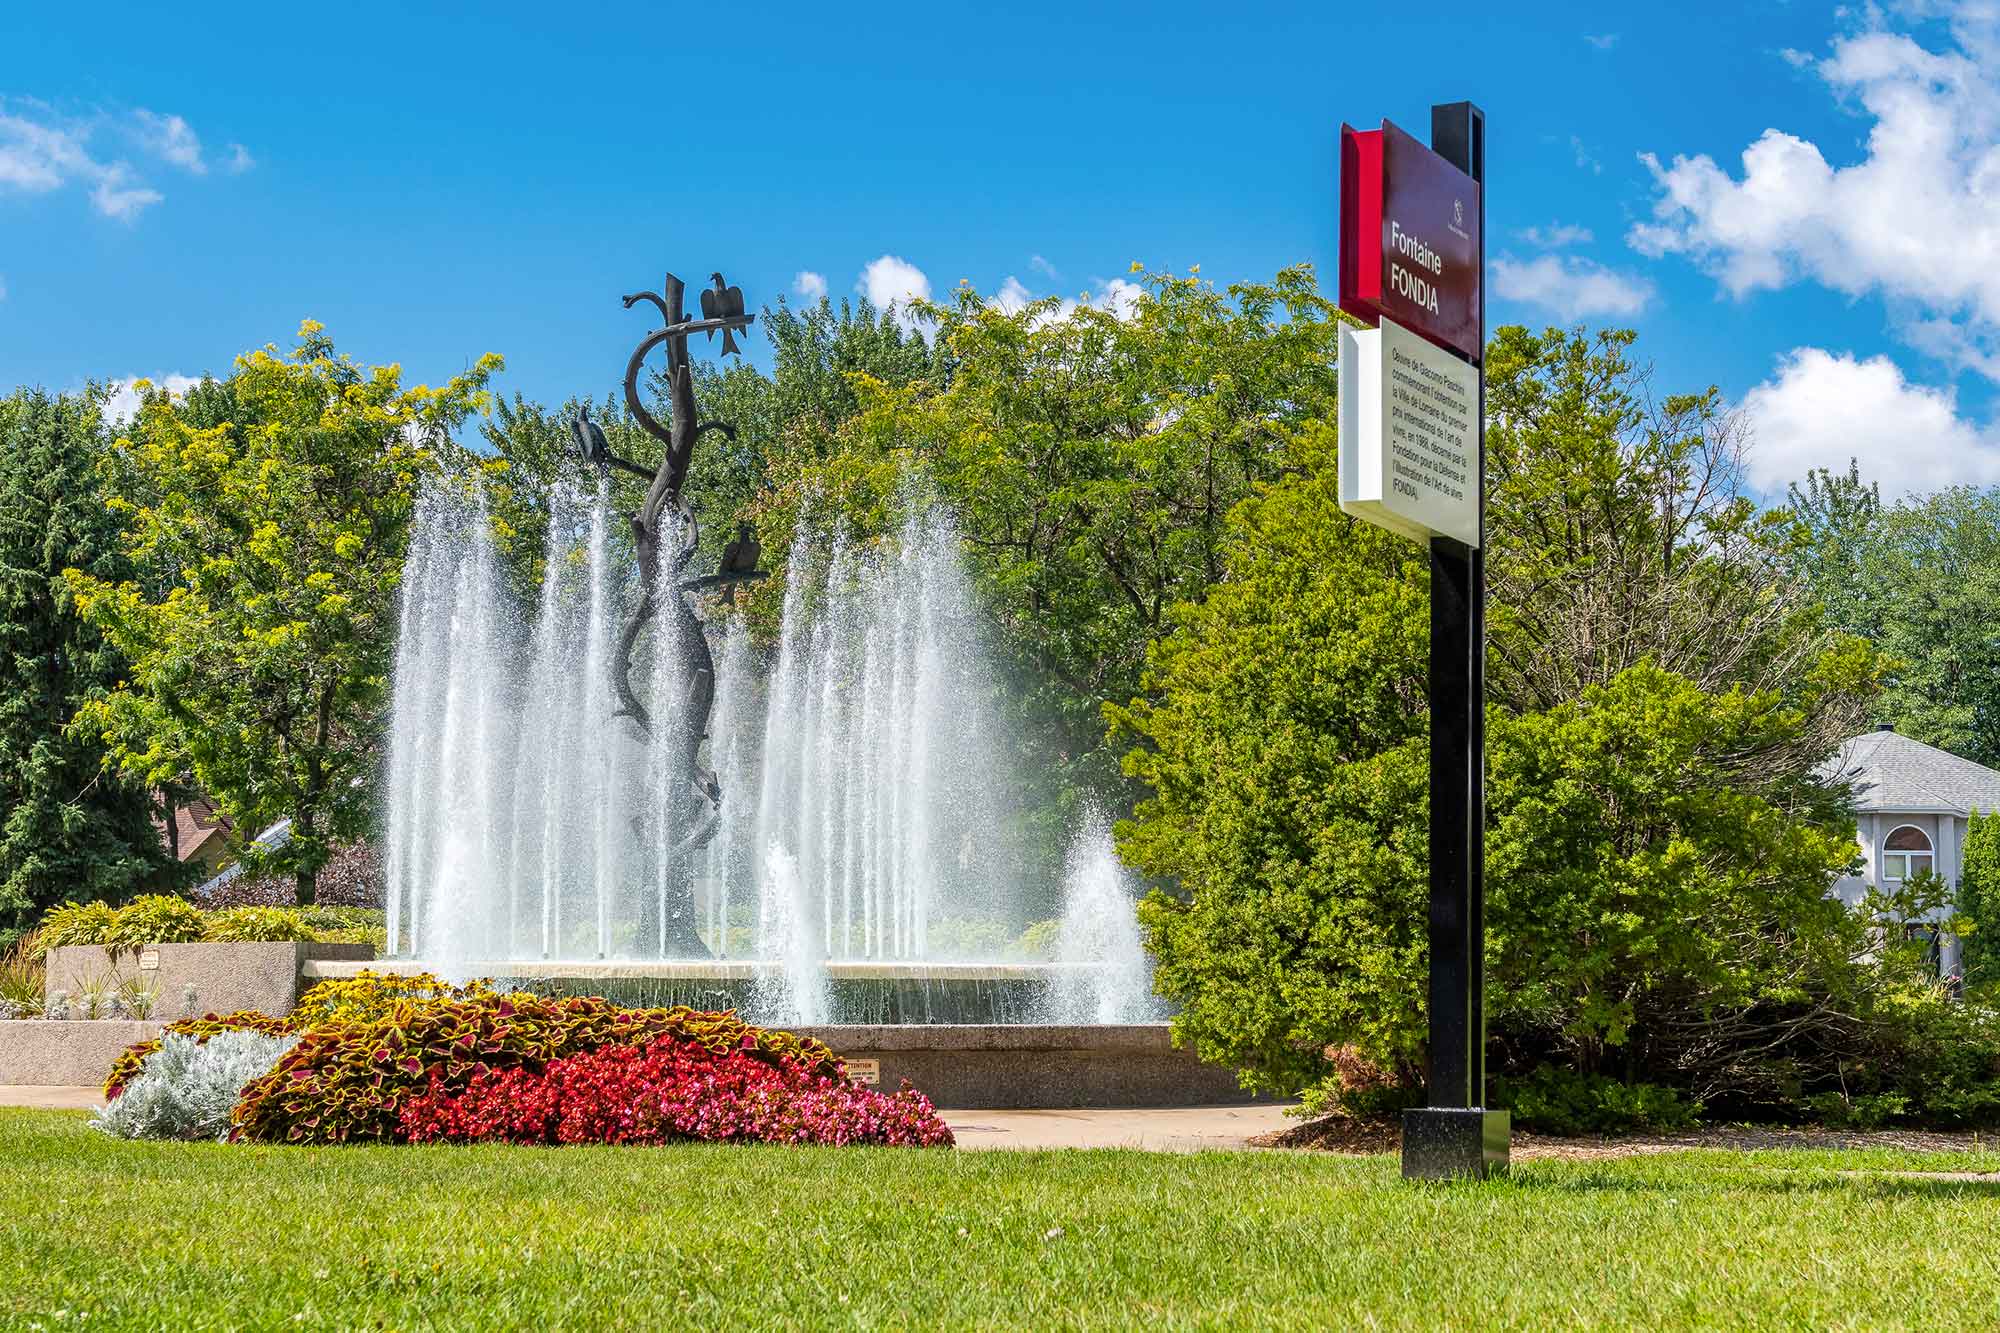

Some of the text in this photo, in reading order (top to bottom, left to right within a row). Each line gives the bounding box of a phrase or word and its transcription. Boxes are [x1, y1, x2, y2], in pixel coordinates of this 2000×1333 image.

[1392, 221, 1441, 275] Fontaine
[1391, 263, 1439, 315] FONDIA
[1411, 360, 1419, 373] de
[1393, 384, 1398, 398] la
[1398, 387, 1410, 404] Ville
[1411, 395, 1418, 408] de
[1441, 411, 1448, 423] du
[1458, 402, 1468, 415] par
[1403, 409, 1436, 435] international
[1437, 425, 1444, 439] de
[1455, 436, 1462, 448] de
[1407, 432, 1415, 441] en
[1392, 440, 1420, 464] Fondation
[1420, 456, 1433, 469] pour
[1433, 459, 1438, 472] la
[1423, 474, 1431, 487] de
[1443, 483, 1450, 495] de
